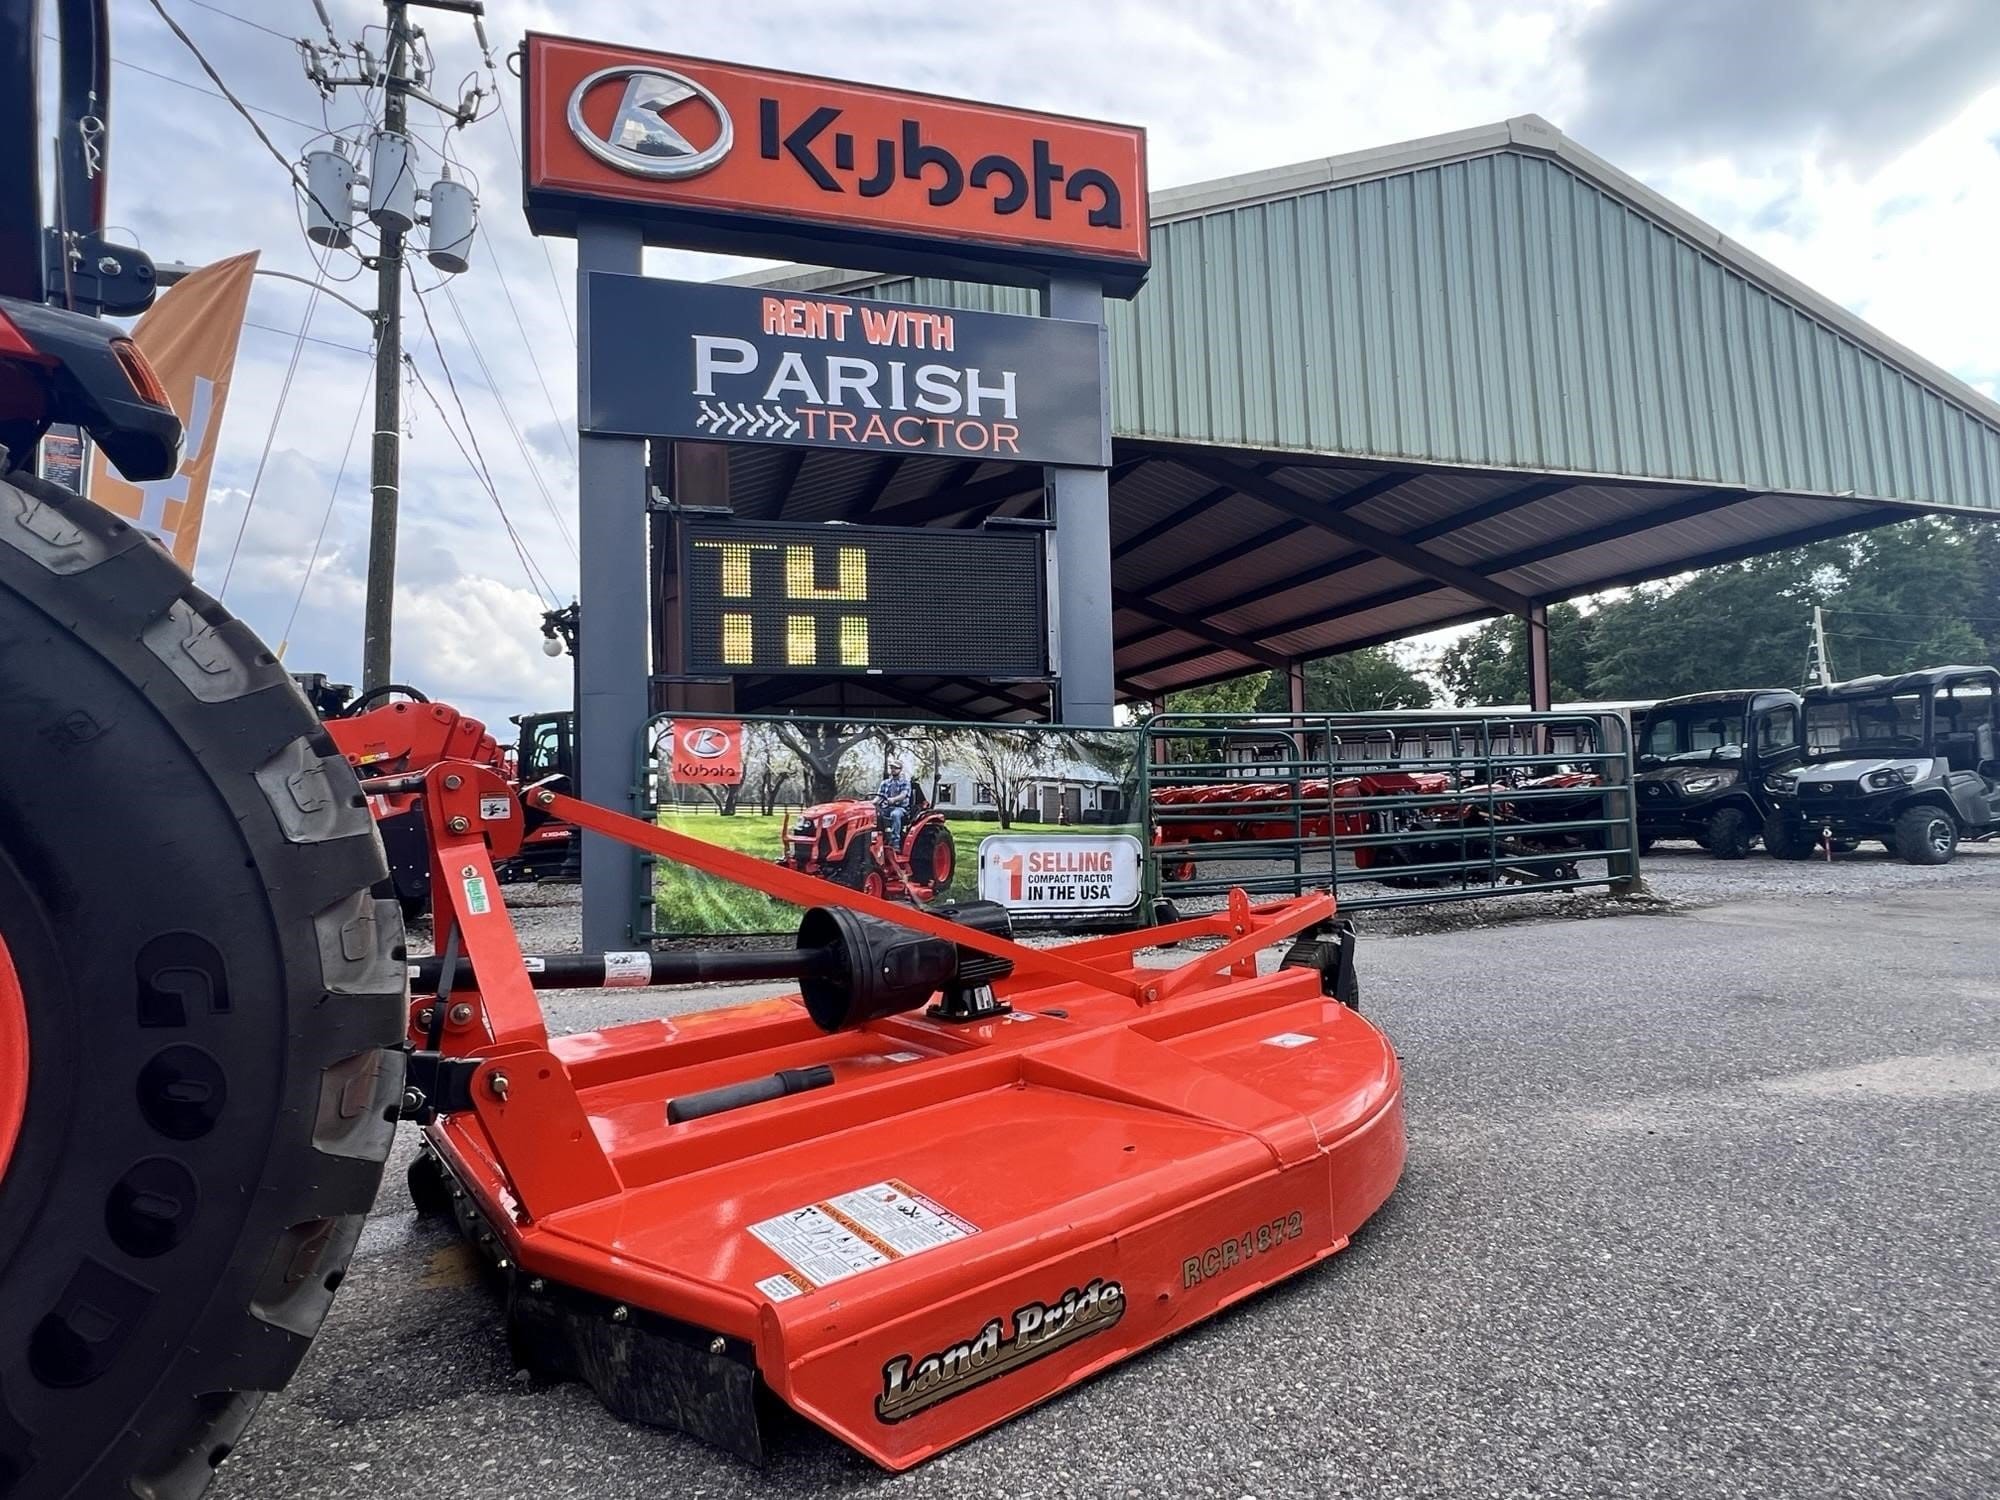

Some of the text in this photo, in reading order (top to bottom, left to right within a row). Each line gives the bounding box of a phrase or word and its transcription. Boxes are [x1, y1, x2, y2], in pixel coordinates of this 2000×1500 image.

[760, 97, 1122, 229] Kubota
[763, 297, 954, 351] RENT WITH
[691, 335, 1018, 419] PARISH
[796, 408, 1020, 453] TRACTOR
[678, 763, 736, 777] Kubota
[1028, 852, 1112, 872] SELLING
[1028, 873, 1113, 884] COMPACT TRACTOR
[1028, 886, 1043, 900] IN
[1048, 885, 1075, 900] THE
[1183, 1211, 1302, 1289] RCR1872
[881, 1279, 1122, 1405] Land Pride
